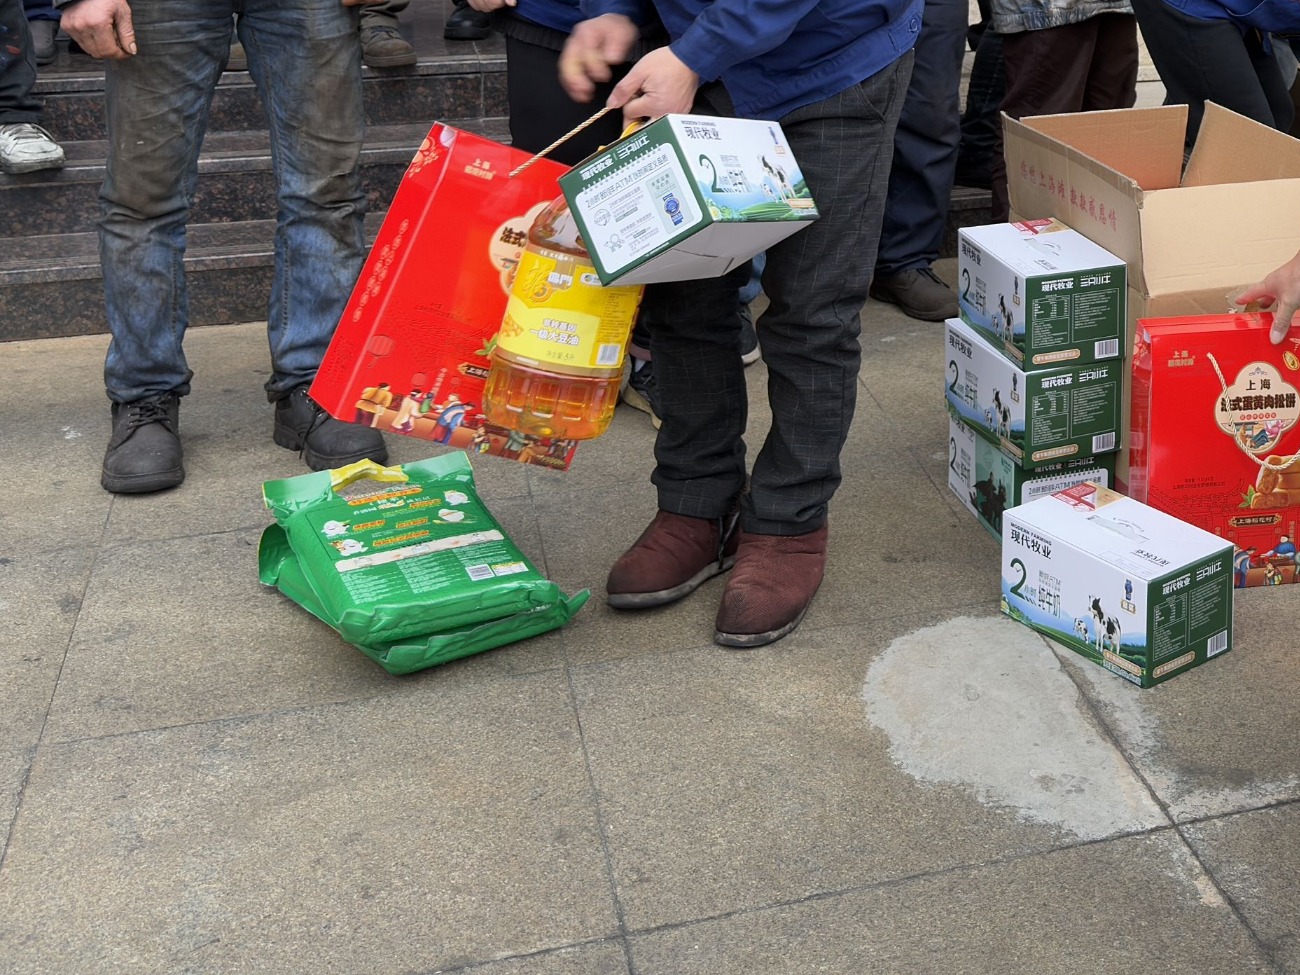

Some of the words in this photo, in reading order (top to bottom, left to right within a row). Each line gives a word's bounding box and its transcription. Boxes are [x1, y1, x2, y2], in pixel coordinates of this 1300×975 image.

[1245, 378, 1271, 391] 上海
[1011, 529, 1052, 560] 现代牧业
